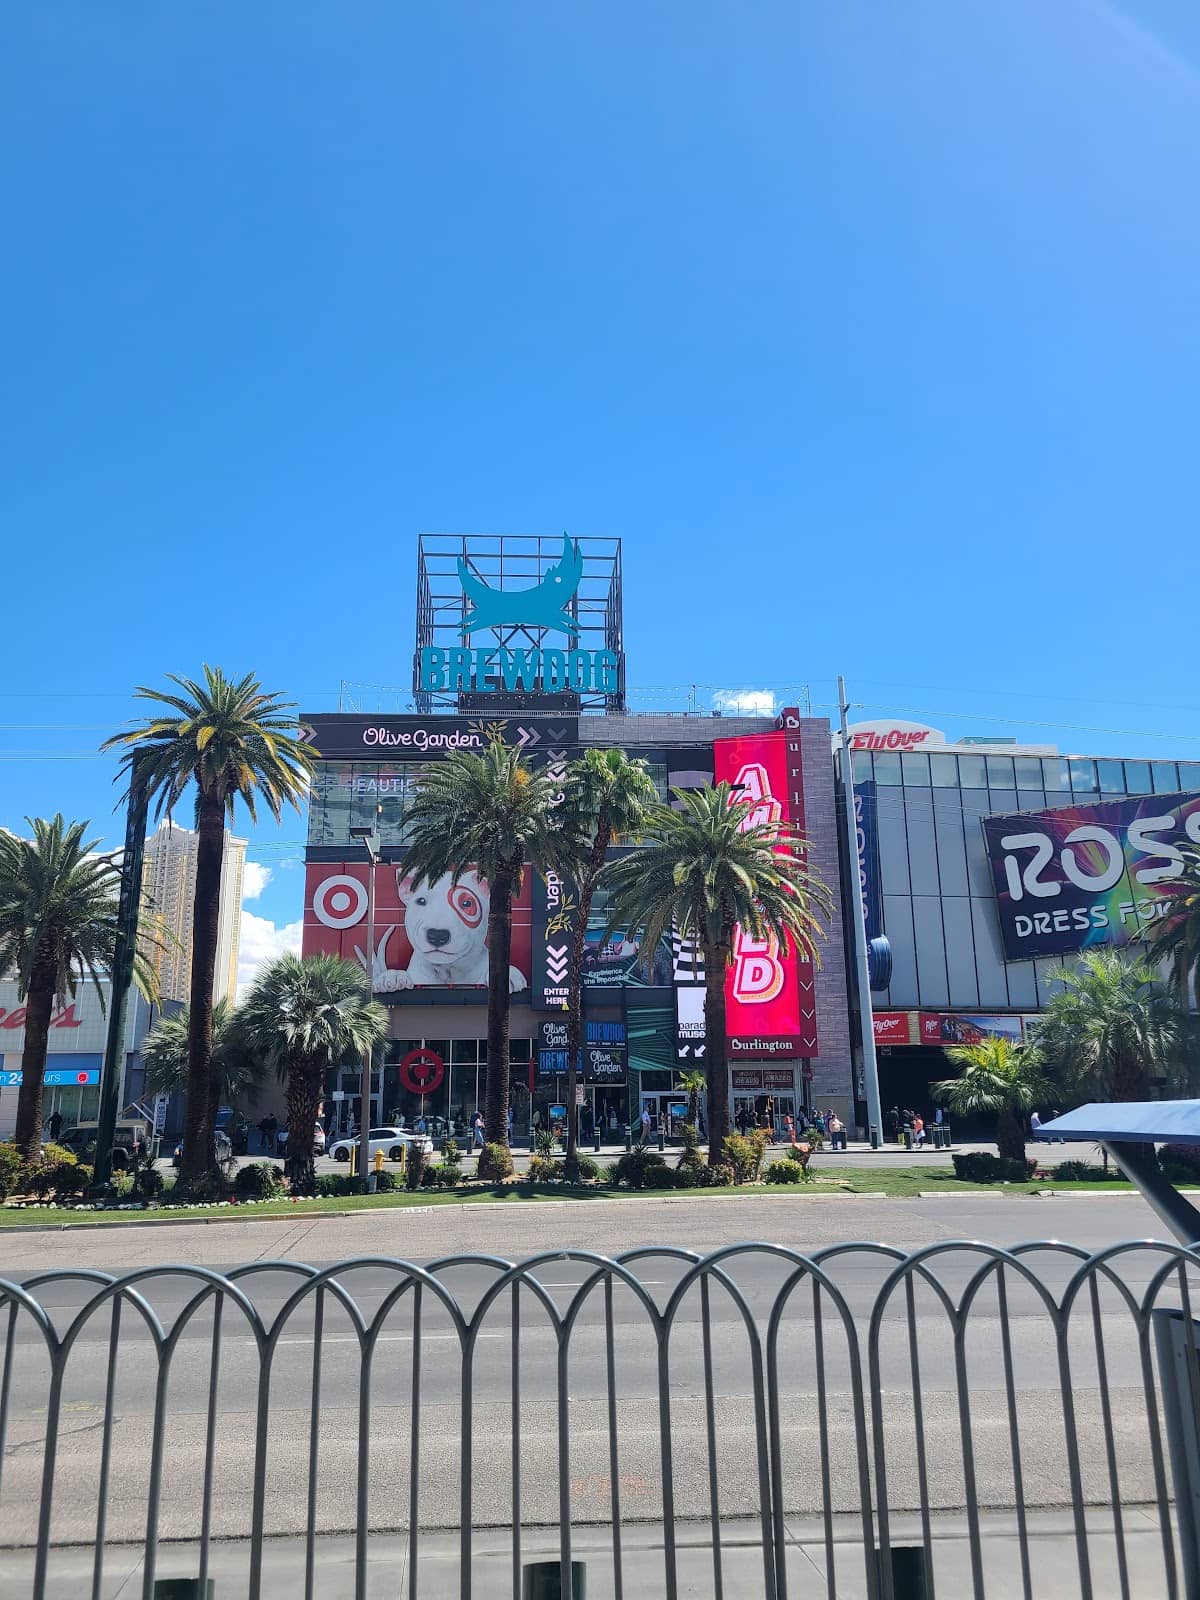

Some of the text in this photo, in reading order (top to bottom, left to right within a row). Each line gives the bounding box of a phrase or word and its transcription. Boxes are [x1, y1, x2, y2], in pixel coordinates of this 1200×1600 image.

[421, 647, 618, 693] BREWDOG
[363, 728, 483, 751] Olive Garden
[1015, 905, 1109, 938] DRESS
[543, 987, 570, 996] ENTER
[545, 997, 568, 1005] HERE
[543, 1023, 567, 1034] Olive
[731, 1038, 793, 1053] Burlington
[590, 1050, 611, 1062] Olive
[593, 1061, 622, 1075] Garden
